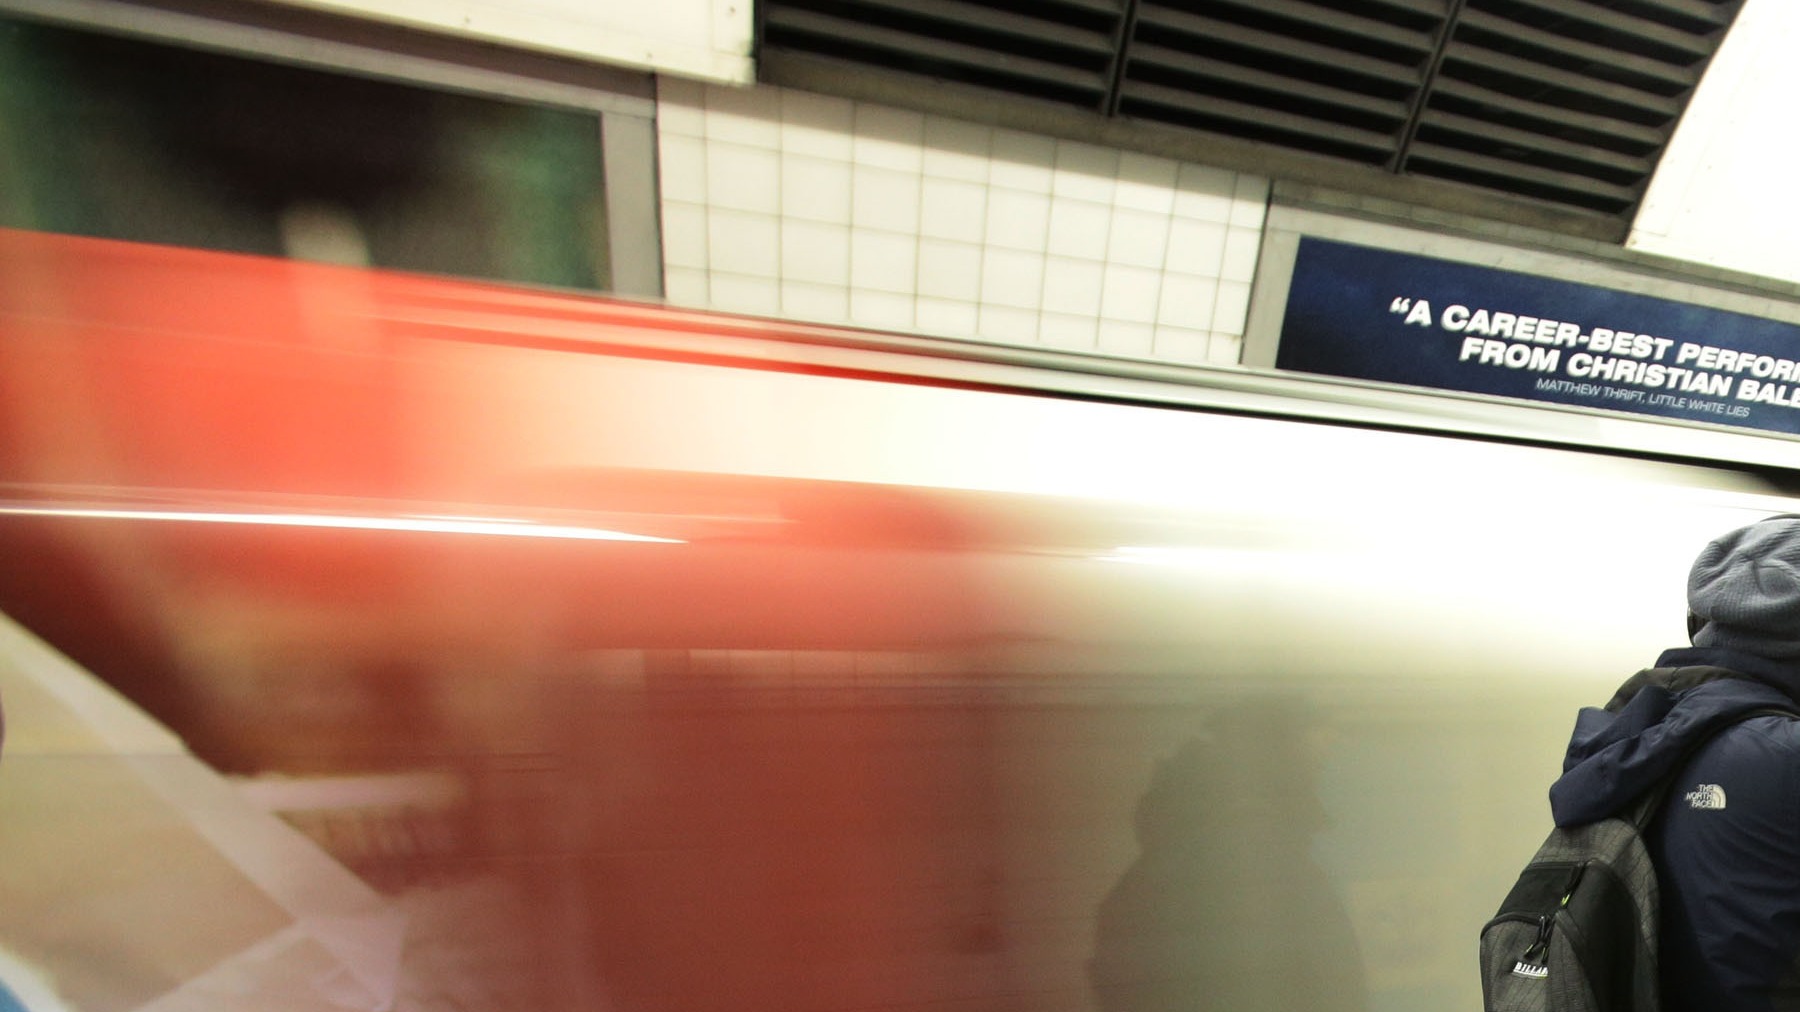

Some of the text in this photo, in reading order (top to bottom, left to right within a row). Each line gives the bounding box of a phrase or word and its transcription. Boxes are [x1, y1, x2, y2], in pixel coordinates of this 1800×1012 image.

[1440, 304, 1675, 360] CAREER-BEST
[1458, 336, 1561, 373] FROM
[1566, 352, 1733, 398] CHRISTIAN
[1535, 377, 1751, 418] MATTHEW THRIFT, LITTLE WHITE LIES
[1686, 791, 1713, 801] NORTH
[1691, 800, 1713, 809] FACE
